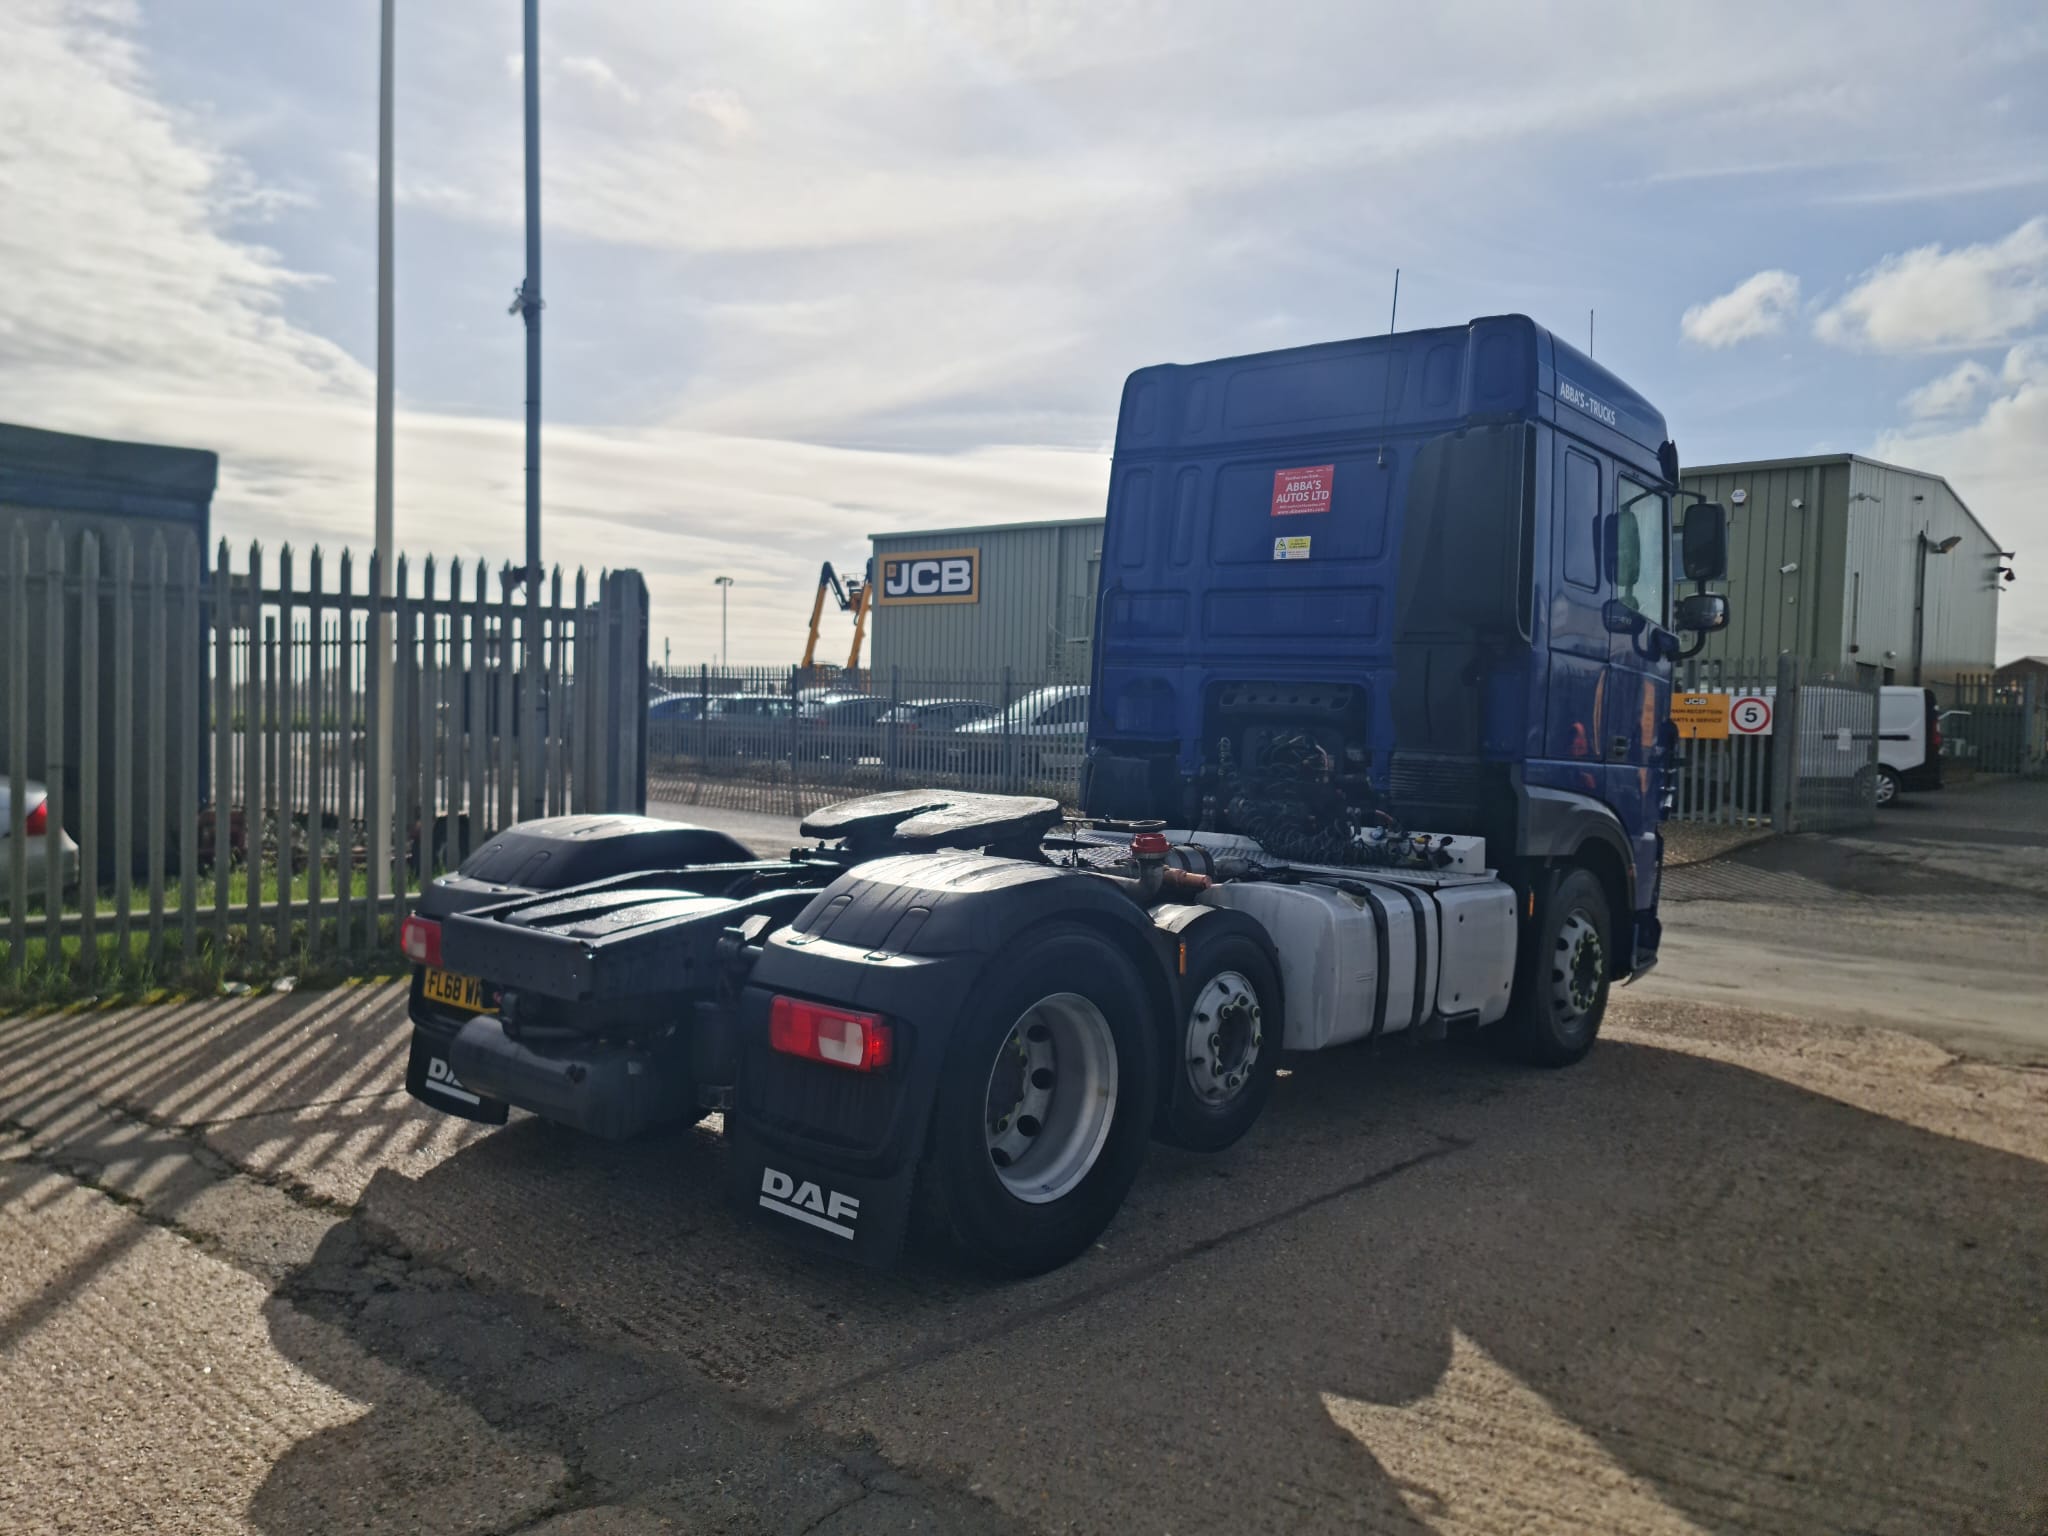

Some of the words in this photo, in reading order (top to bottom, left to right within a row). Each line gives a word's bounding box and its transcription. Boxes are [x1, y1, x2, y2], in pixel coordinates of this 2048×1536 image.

[1275, 491, 1310, 504] AUTOS
[1311, 490, 1330, 501] LTD
[1285, 480, 1322, 493] ABBA'S
[886, 560, 971, 595] JCB
[1744, 707, 1758, 723] 5
[428, 971, 462, 1001] FL68
[762, 1167, 860, 1219] DAF
